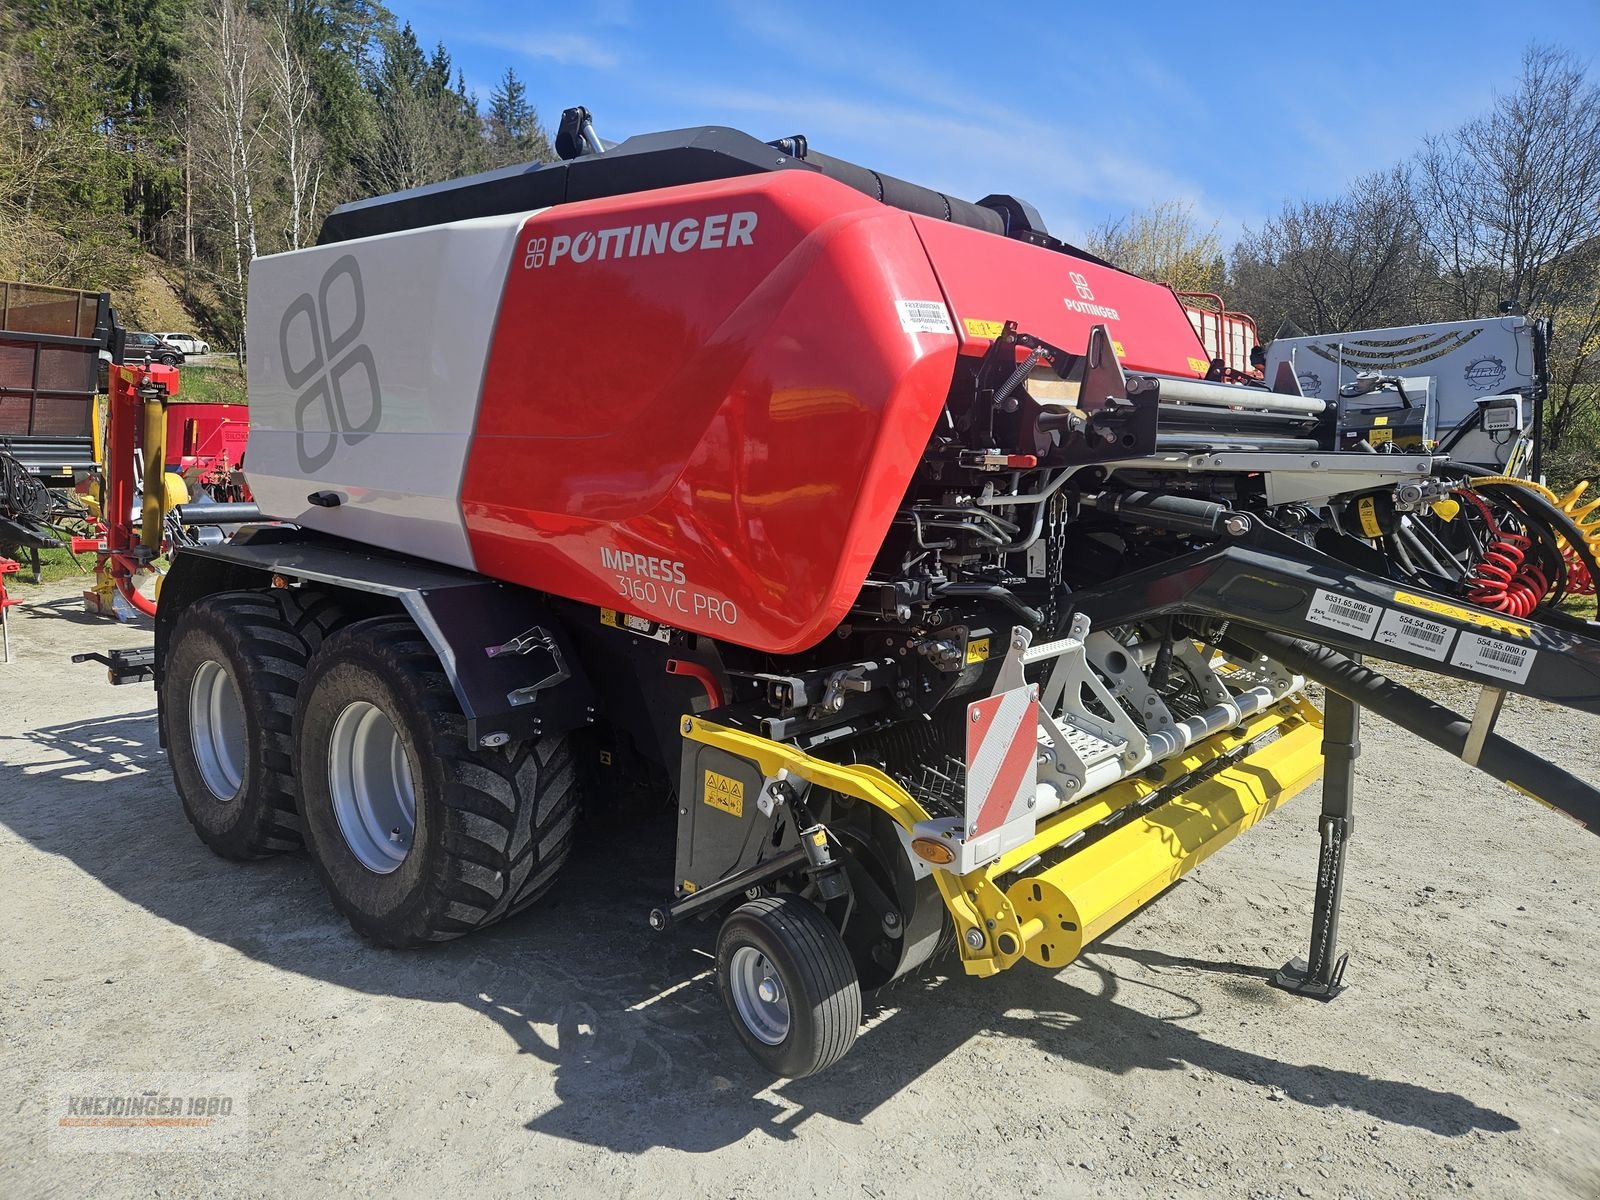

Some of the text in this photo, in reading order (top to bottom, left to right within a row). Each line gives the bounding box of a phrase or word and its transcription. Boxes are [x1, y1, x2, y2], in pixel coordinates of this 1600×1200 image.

[548, 211, 758, 266] PÖTTINGER
[600, 546, 686, 585] IMPRESS
[616, 574, 737, 625] 3160 VC PRO
[1324, 594, 1374, 614] 8331.65.006.0
[1399, 615, 1447, 635] 554.54.005.2
[1476, 637, 1527, 656] 554.55.000.0
